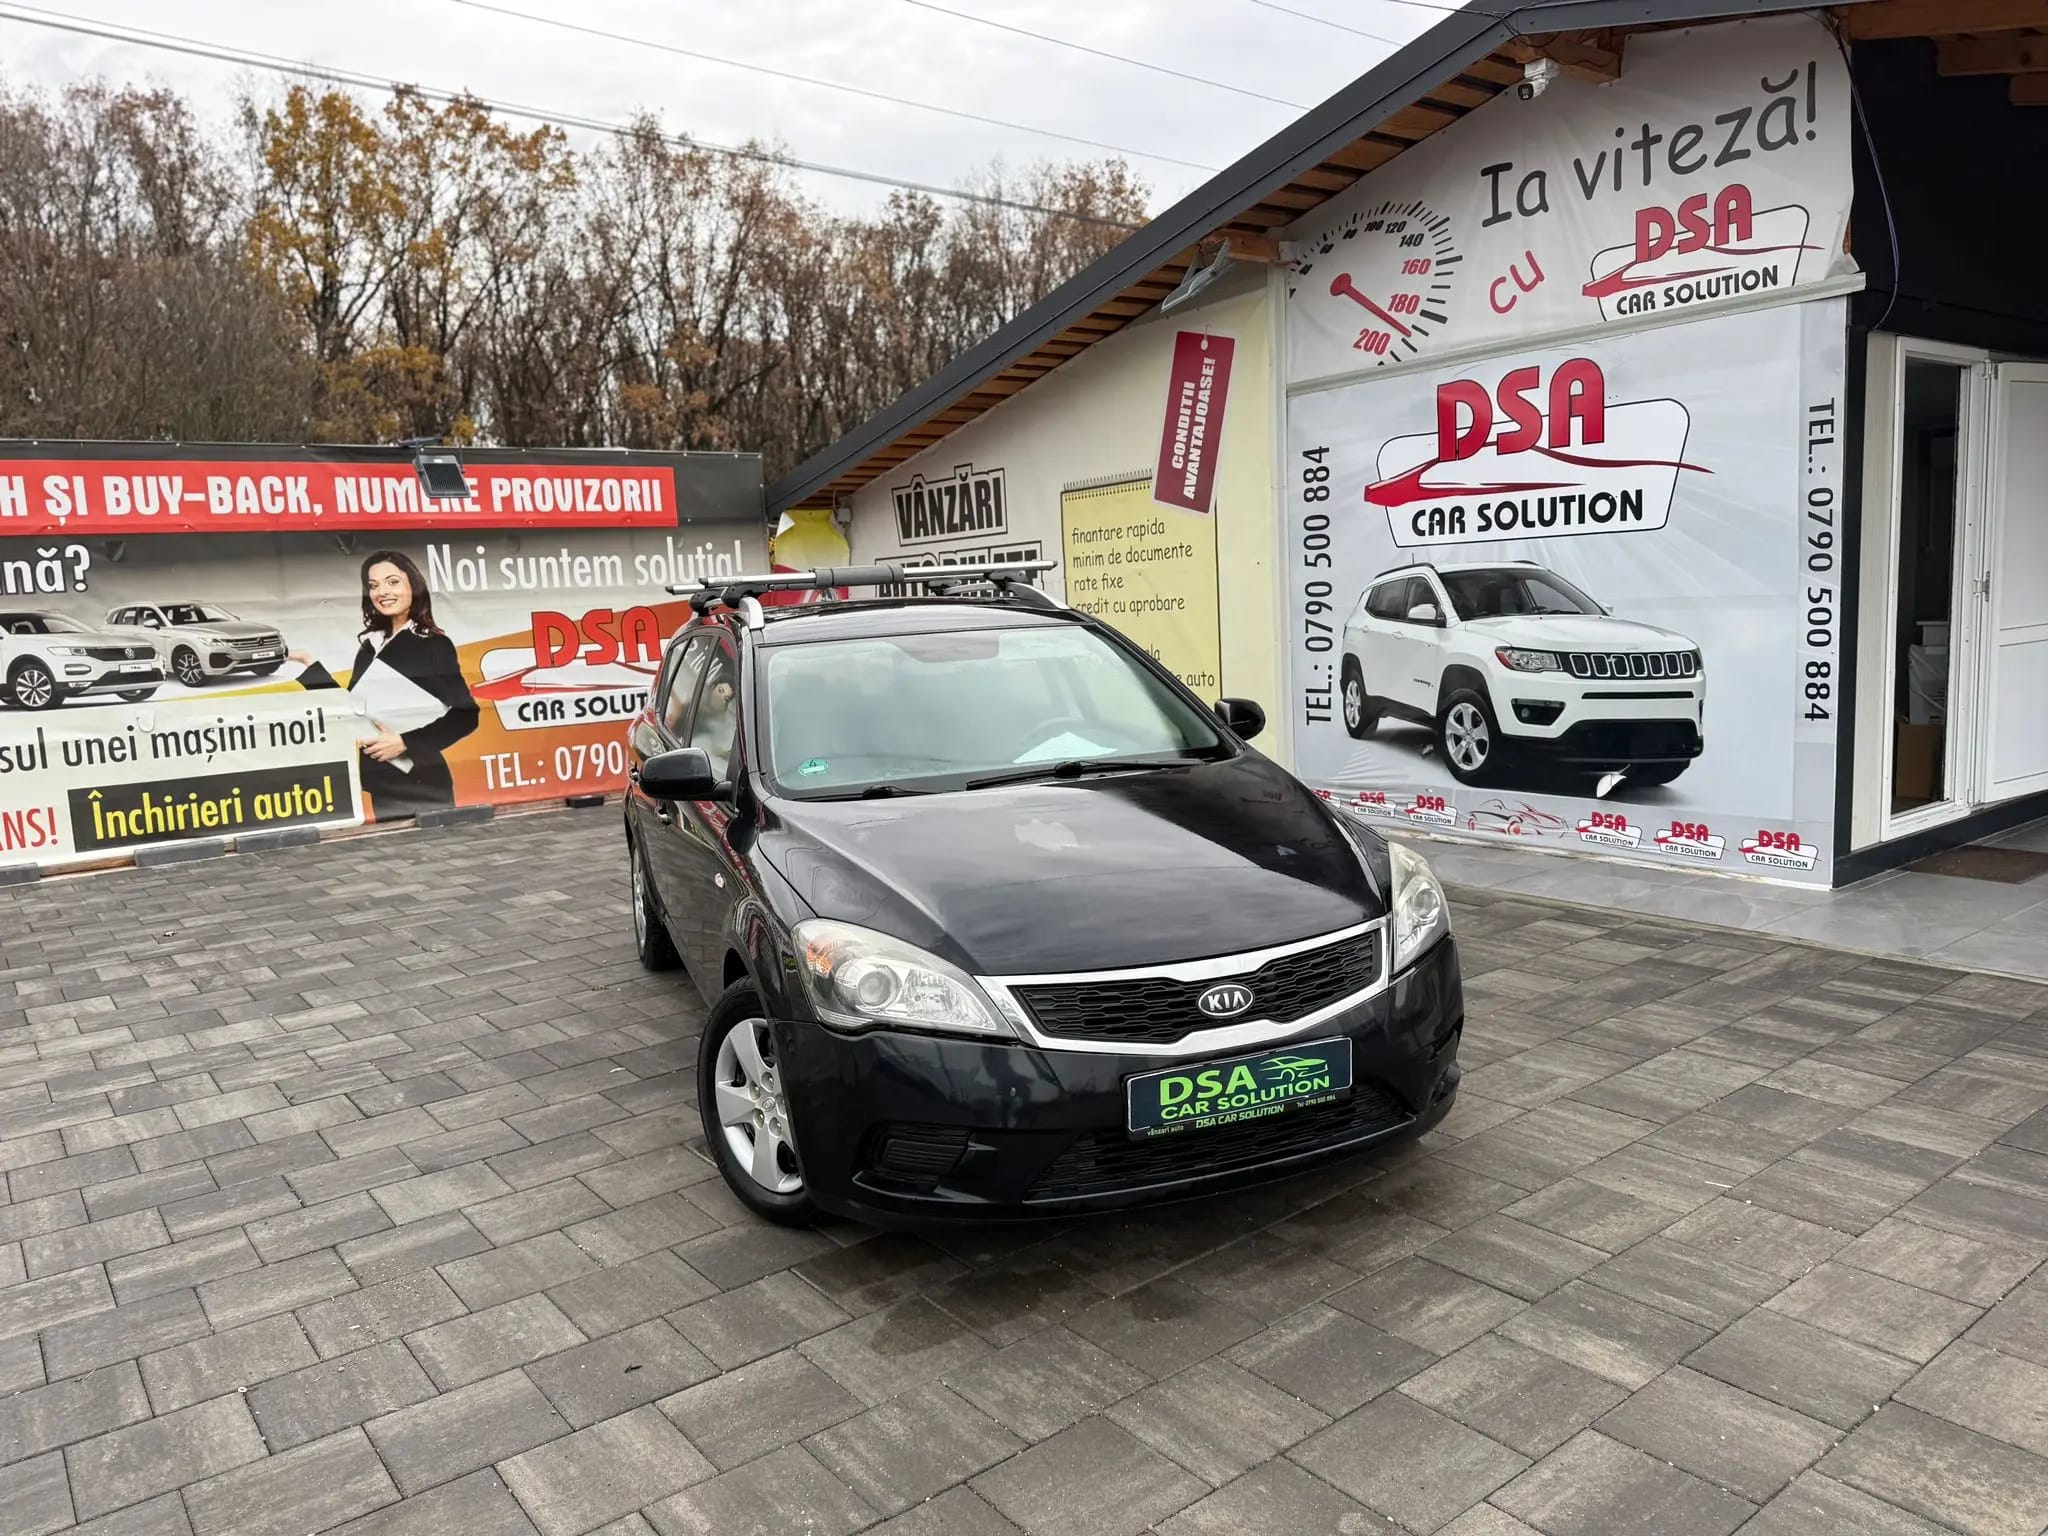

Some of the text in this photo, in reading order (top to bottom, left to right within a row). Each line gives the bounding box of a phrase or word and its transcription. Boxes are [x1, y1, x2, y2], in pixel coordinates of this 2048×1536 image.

[1480, 61, 1817, 228] Ia viteză!
[1384, 220, 1407, 234] 120
[1399, 233, 1424, 248] 140
[1635, 183, 1753, 263] DSA
[1401, 258, 1431, 275] 160
[1488, 249, 1546, 314] cu
[1387, 293, 1420, 314] 180
[1616, 265, 1779, 315] CAR SOLUTION
[1353, 328, 1391, 355] 200
[1171, 381, 1196, 470] CONDITII
[1183, 357, 1216, 500] AVANTAJOASE!
[1437, 357, 1605, 463] DSA
[1302, 445, 1330, 503] 884
[43, 475, 89, 527] ȘI
[102, 475, 323, 516] BUY-BACK,
[490, 477, 663, 514] PROVIZORII
[896, 472, 1003, 540] VÂNZĂRI
[1411, 489, 1643, 537] CAR SOLUTION
[1072, 517, 1165, 545] finantare rapida
[1303, 513, 1332, 568] 500
[1807, 487, 1833, 573] 0790
[427, 544, 486, 593] Noi
[499, 548, 624, 591] suntem
[1072, 542, 1193, 569] minim de documente
[1074, 572, 1124, 592] rate fixe
[1113, 601, 1126, 613] cu
[1129, 594, 1185, 616] aprobare
[1304, 581, 1333, 652] 0790
[1806, 586, 1832, 647] 500
[531, 605, 663, 669] DSA
[1186, 671, 1215, 687] auto
[1804, 661, 1831, 722] 884
[517, 699, 565, 722] CAR
[61, 725, 138, 766] unei
[151, 714, 257, 763] mașini
[269, 707, 327, 747] noi!
[480, 740, 624, 791] TEL.: 0790
[87, 775, 335, 840] Închirieri auto!
[1359, 791, 1386, 805] DSA
[1416, 794, 1445, 812] DSA
[1584, 834, 1634, 847] CAR SOLUTION
[1591, 811, 1627, 832] DSA
[1671, 820, 1709, 842] DSA
[1758, 829, 1801, 851] DSA
[1665, 844, 1717, 858] CAR SOLUTION
[1751, 854, 1808, 869] CAR SOLUTION
[1208, 991, 1246, 1012] KIA
[1160, 1064, 1258, 1106] DSA
[1160, 1075, 1330, 1120] CAR SOLUTION
[1195, 1104, 1285, 1129] DSA CAR SOLUTION
